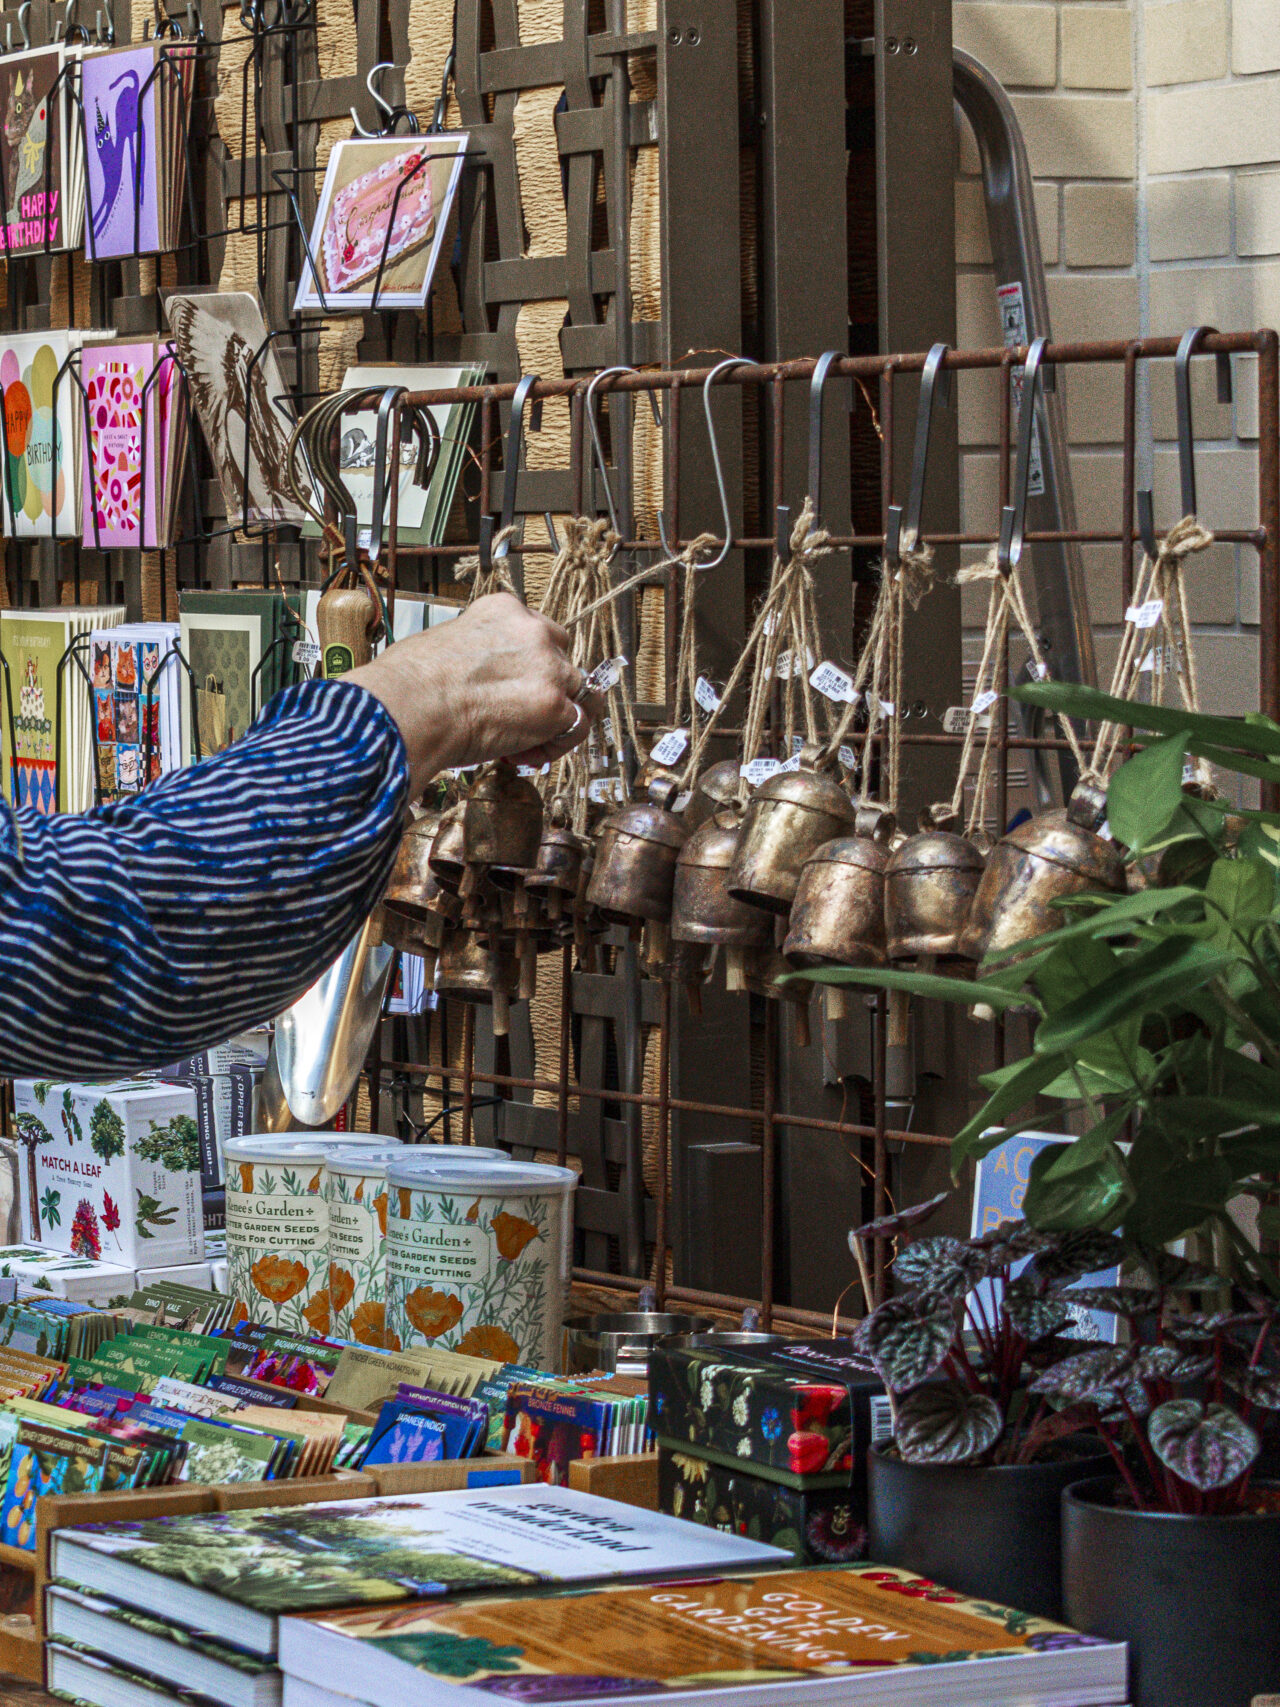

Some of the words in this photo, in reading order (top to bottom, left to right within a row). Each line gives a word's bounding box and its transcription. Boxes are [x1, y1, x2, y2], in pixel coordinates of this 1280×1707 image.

[22, 190, 59, 219] HAPY
[6, 410, 29, 433] HAPPY
[26, 440, 62, 466] BIRTHDY
[202, 1102, 211, 1141] STRING
[41, 1155, 71, 1173] MATCH
[73, 1161, 80, 1174] A
[81, 1164, 102, 1179] LEAF
[256, 1200, 304, 1217] Garden
[244, 1222, 280, 1232] GARDEN
[284, 1225, 320, 1233] SEEDS
[339, 1232, 363, 1243] SEEDS
[412, 1228, 461, 1247] Garden
[248, 1235, 266, 1244] FOR
[269, 1236, 315, 1245] CUTTING
[400, 1250, 436, 1262] GARDEN
[440, 1255, 477, 1265] SEEDS
[424, 1266, 472, 1278] CUTTING
[145, 1297, 160, 1308] DINO
[165, 1302, 182, 1313] KALE
[146, 1330, 170, 1342] LEMON
[182, 1336, 201, 1348] BALM
[273, 1338, 297, 1351] RADIANT
[295, 1343, 317, 1355] RADISH
[315, 1348, 329, 1358] MIX
[106, 1350, 126, 1361] LEMON
[133, 1357, 151, 1368] BALM
[349, 1350, 368, 1362] TENDER
[367, 1356, 387, 1368] GREEN
[386, 1360, 421, 1377] KOMATSUNA
[74, 1364, 95, 1376] LEMON
[102, 1371, 119, 1382] BALM
[218, 1381, 250, 1396] PURPLETOP
[249, 1389, 276, 1402] VERVAIN
[527, 1397, 553, 1411] BRONZE
[553, 1403, 577, 1418] FENNEL
[396, 1412, 424, 1428] JAPANESE
[423, 1420, 448, 1432] INDIGO
[20, 1429, 39, 1441] HONEY
[37, 1433, 54, 1445] DROP
[52, 1436, 75, 1451] CHERRY
[74, 1442, 100, 1458] TOMATO
[109, 1451, 135, 1467] TOMATO
[467, 1501, 653, 1553] wonderland
[518, 1503, 635, 1533] garden
[650, 1593, 847, 1660] GARDENING
[744, 1606, 839, 1638] GATE
[762, 1592, 912, 1642] GOLDEN
